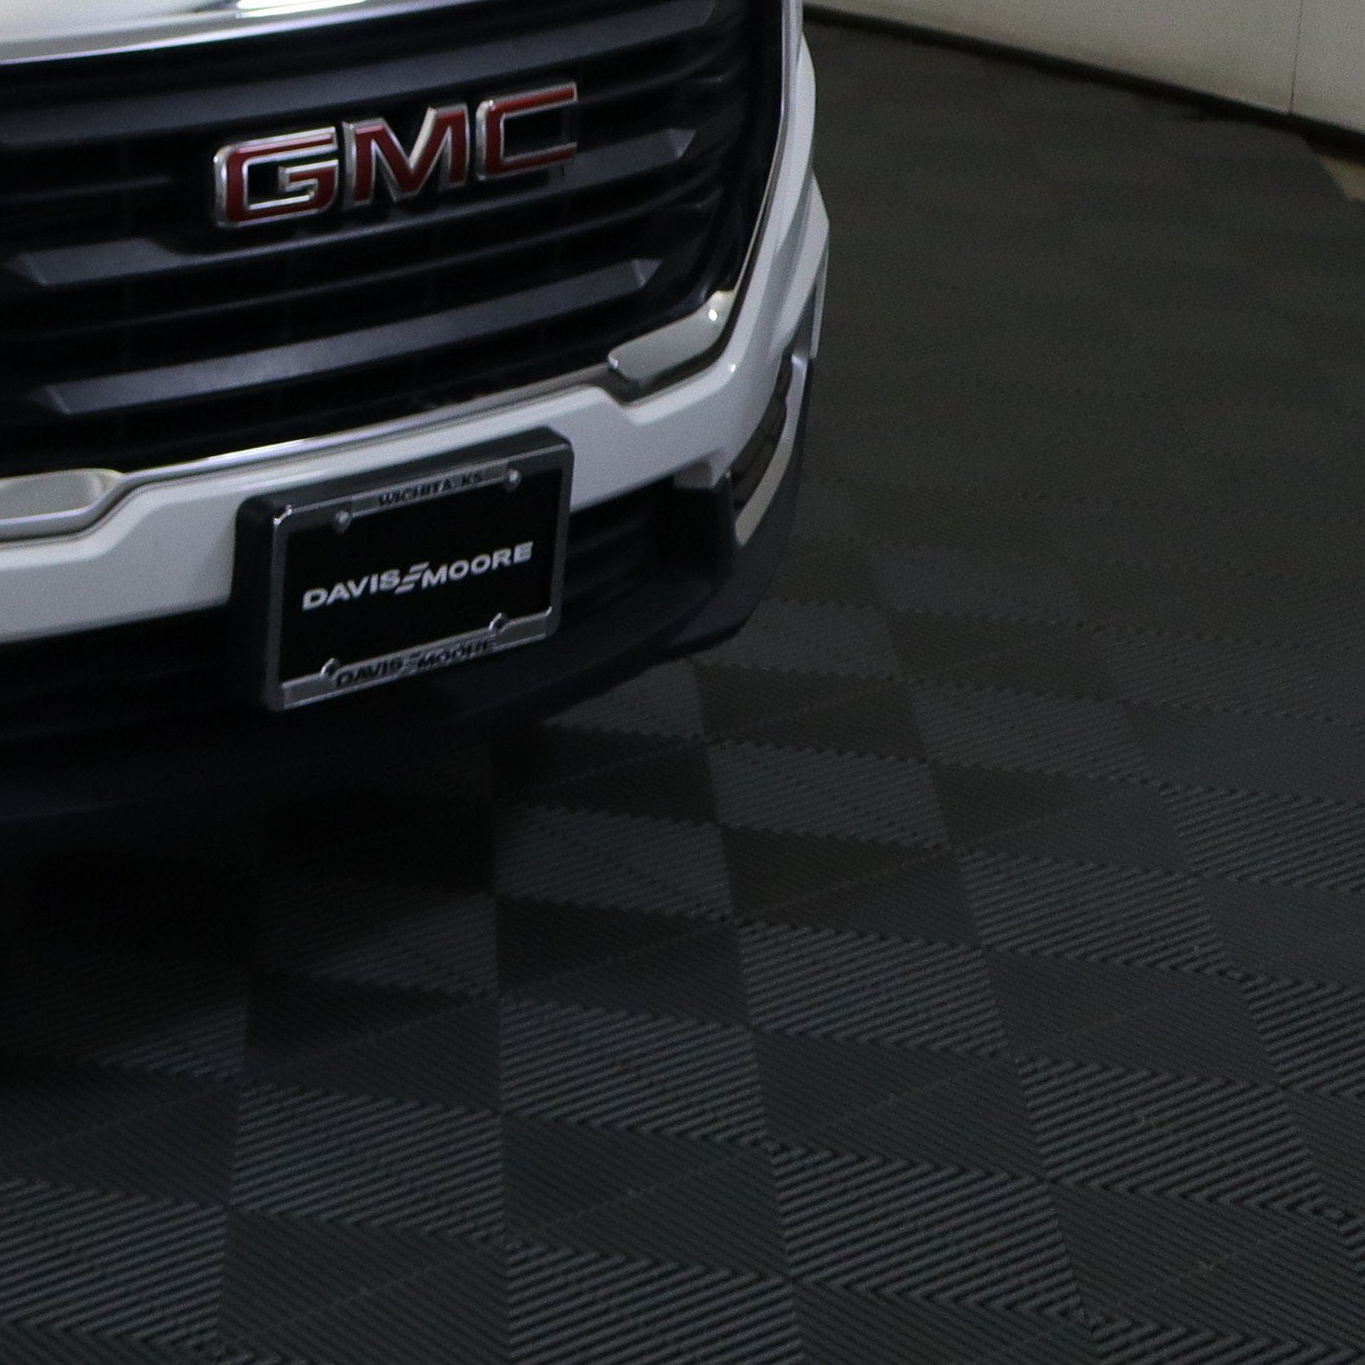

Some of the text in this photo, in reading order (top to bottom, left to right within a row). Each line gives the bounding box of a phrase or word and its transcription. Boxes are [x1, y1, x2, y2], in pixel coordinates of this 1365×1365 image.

[214, 81, 578, 229] GMC
[302, 541, 533, 611] DAVIS MOORE
